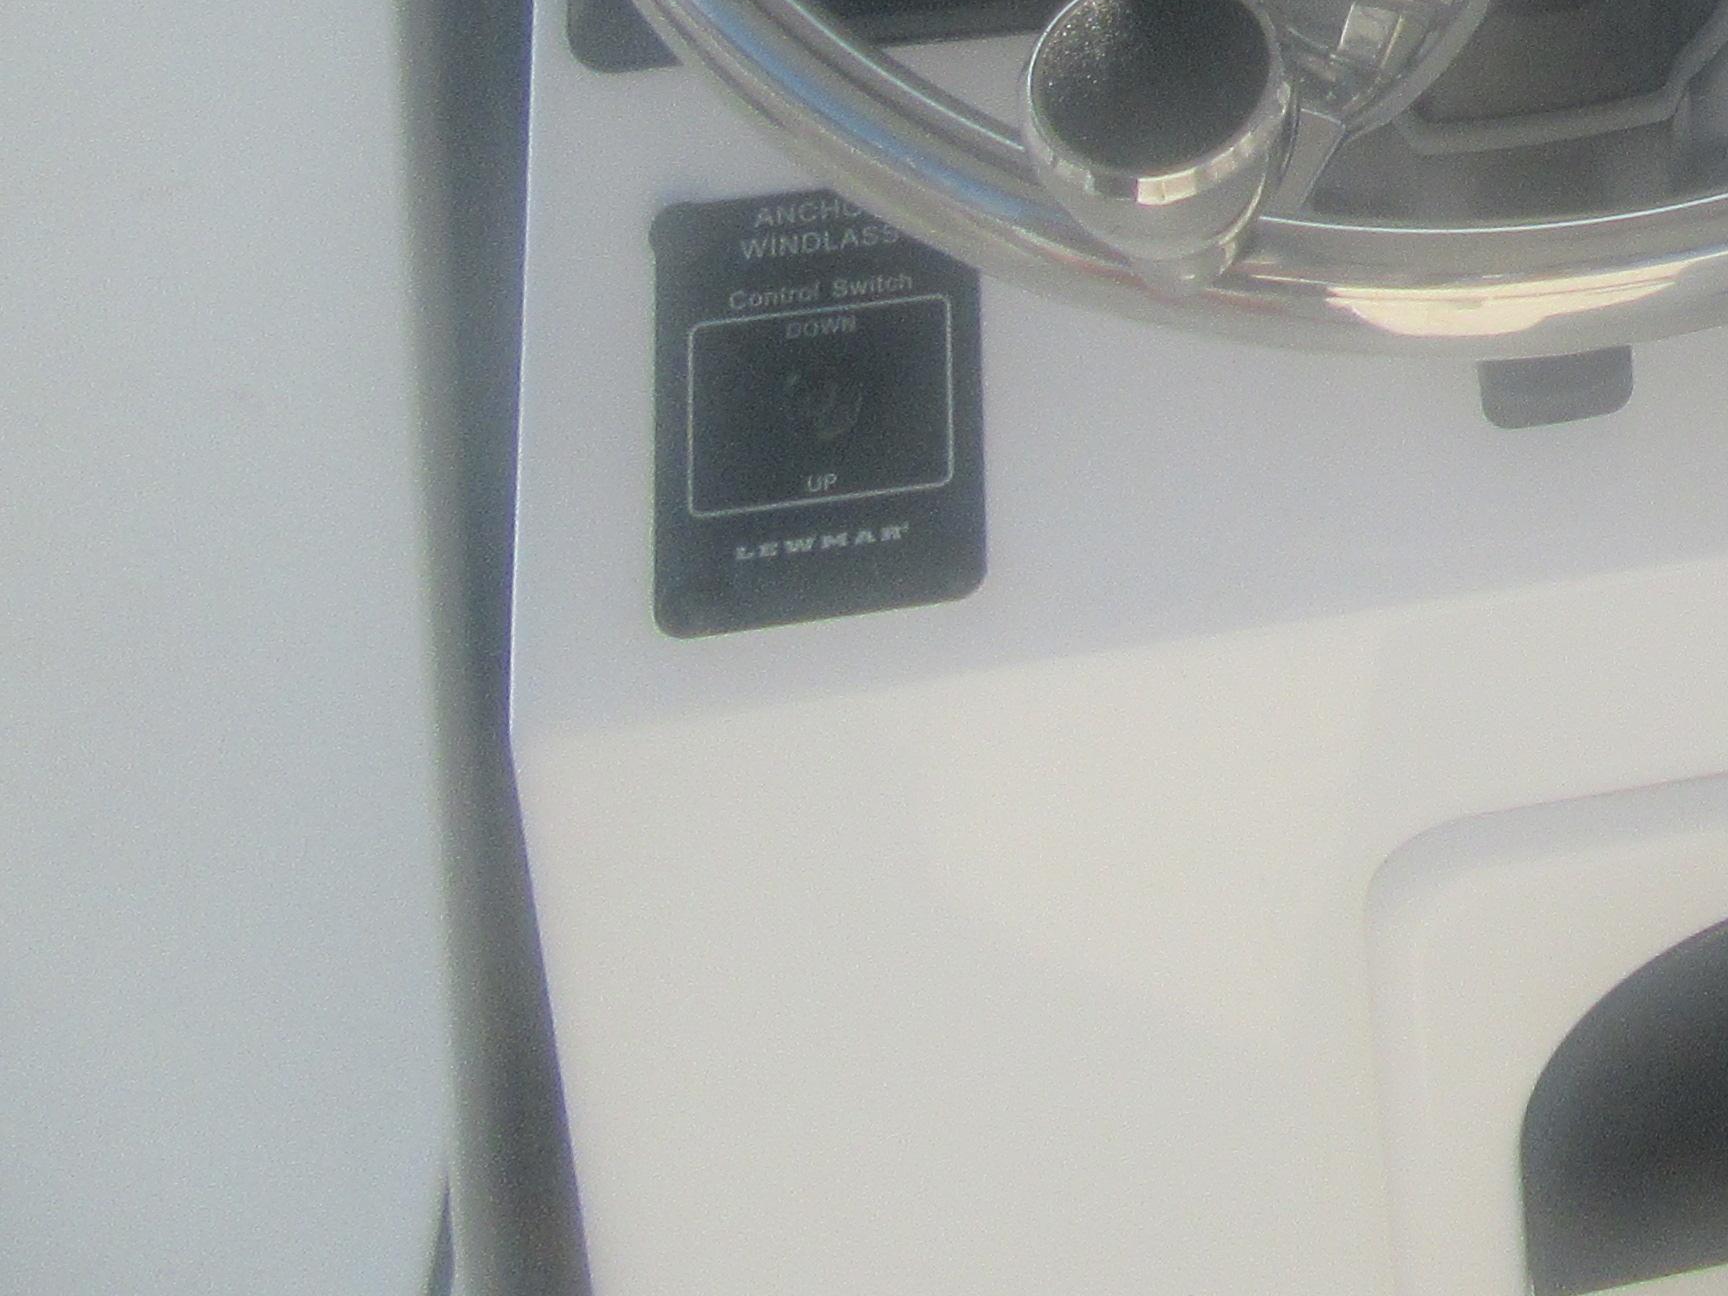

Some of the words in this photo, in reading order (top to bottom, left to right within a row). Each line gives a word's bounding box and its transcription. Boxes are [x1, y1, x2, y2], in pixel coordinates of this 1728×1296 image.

[754, 198, 864, 228] ANCHO
[740, 224, 900, 259] WINDLASS
[728, 280, 822, 310] Control
[831, 272, 914, 298] Switch
[785, 314, 858, 340] DOWN
[807, 473, 838, 493] UP
